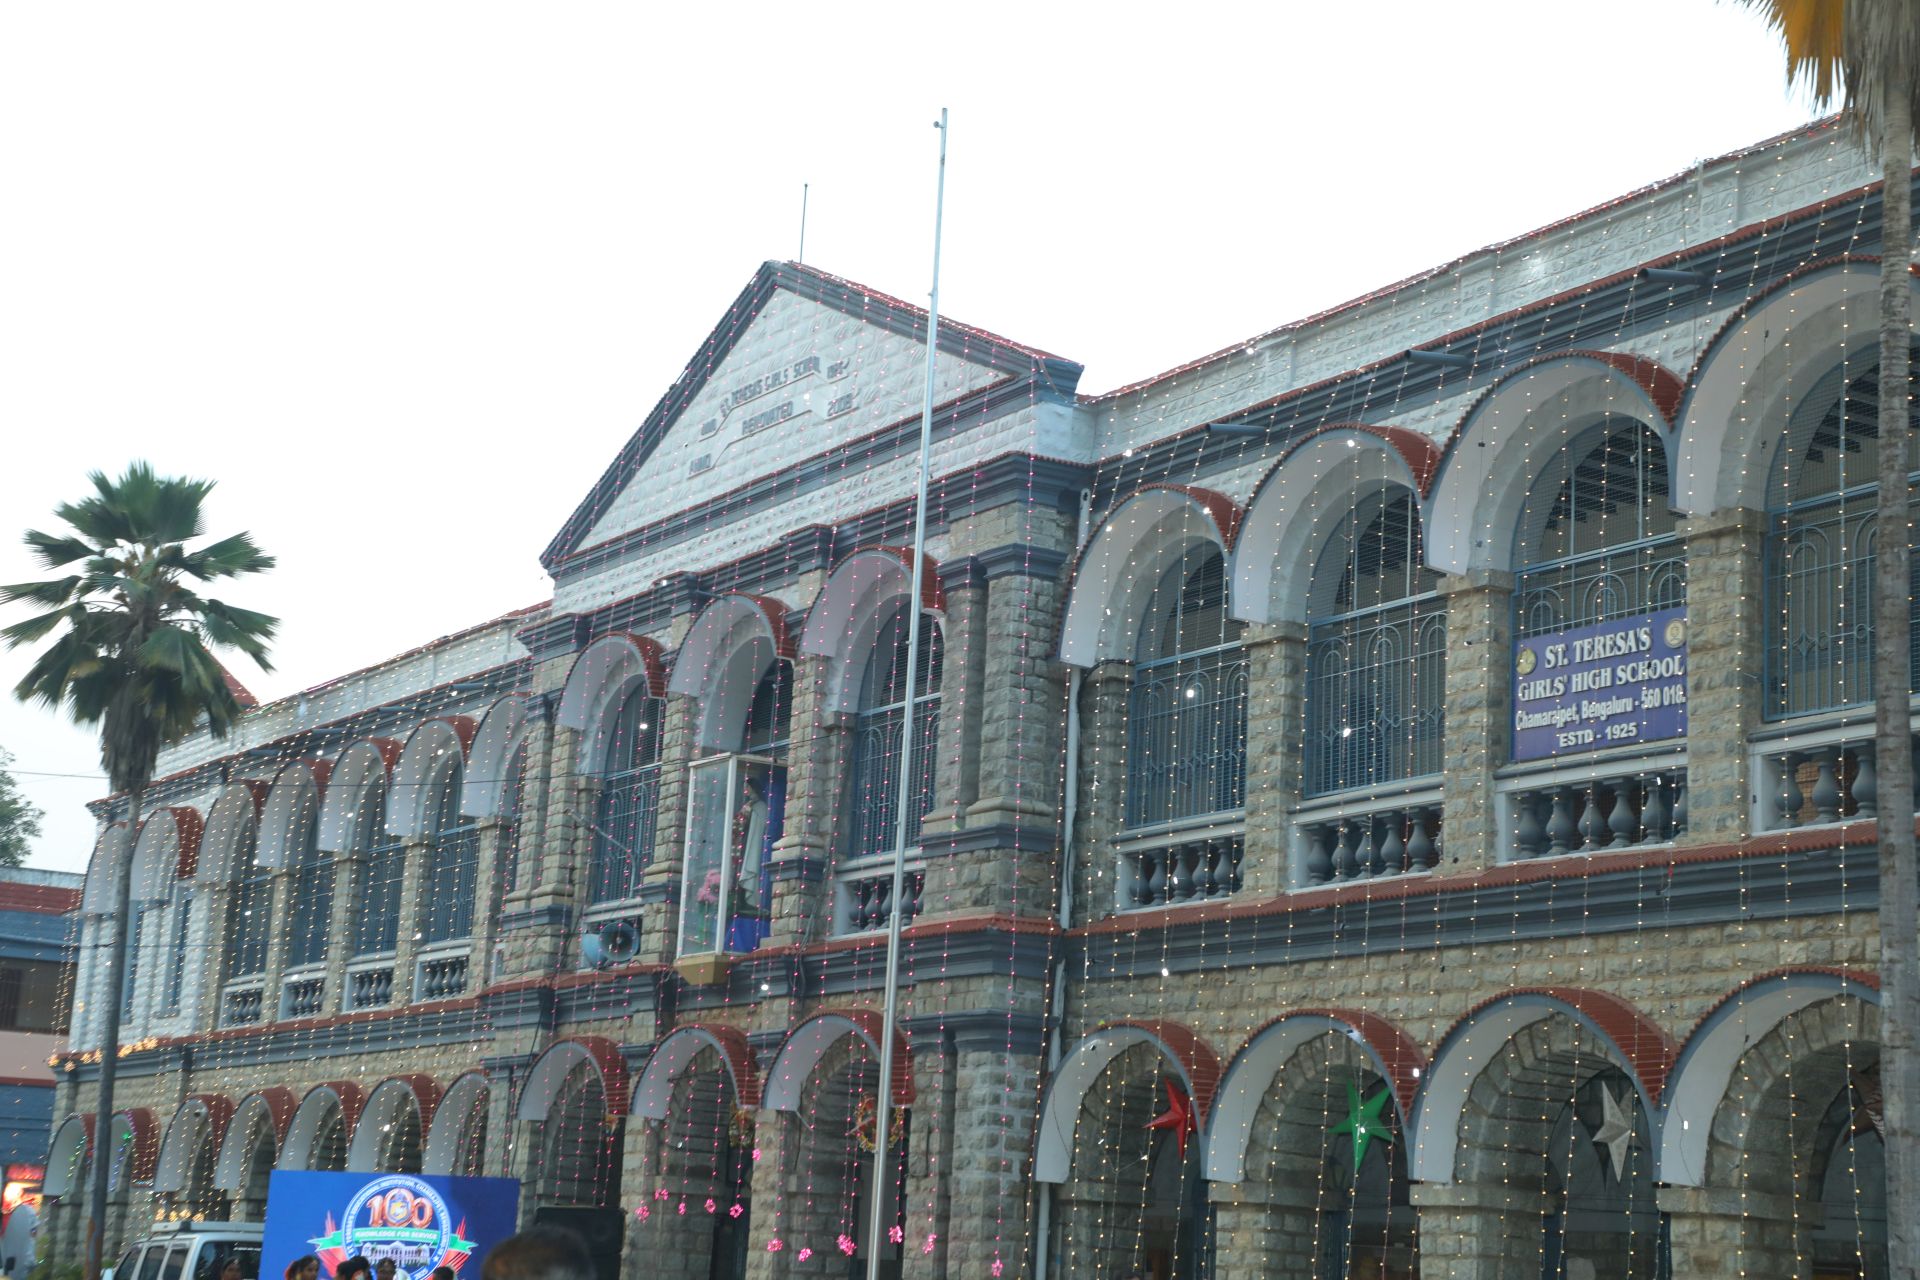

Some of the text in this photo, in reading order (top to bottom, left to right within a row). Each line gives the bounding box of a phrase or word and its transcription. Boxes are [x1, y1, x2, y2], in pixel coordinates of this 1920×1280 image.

[1544, 627, 1650, 669] ST. TERESA'S
[1518, 655, 1685, 702] GIRLS' HIGH SCHOOL
[1516, 704, 1580, 730] Chamarajpet,
[1582, 695, 1634, 721] Bengaluru
[1641, 688, 1661, 710] 560
[1662, 684, 1686, 706] 018.
[1559, 729, 1594, 748] ESTD
[1605, 722, 1638, 740] 1925
[366, 1187, 433, 1228] 100
[411, 1232, 438, 1240] SERVICE
